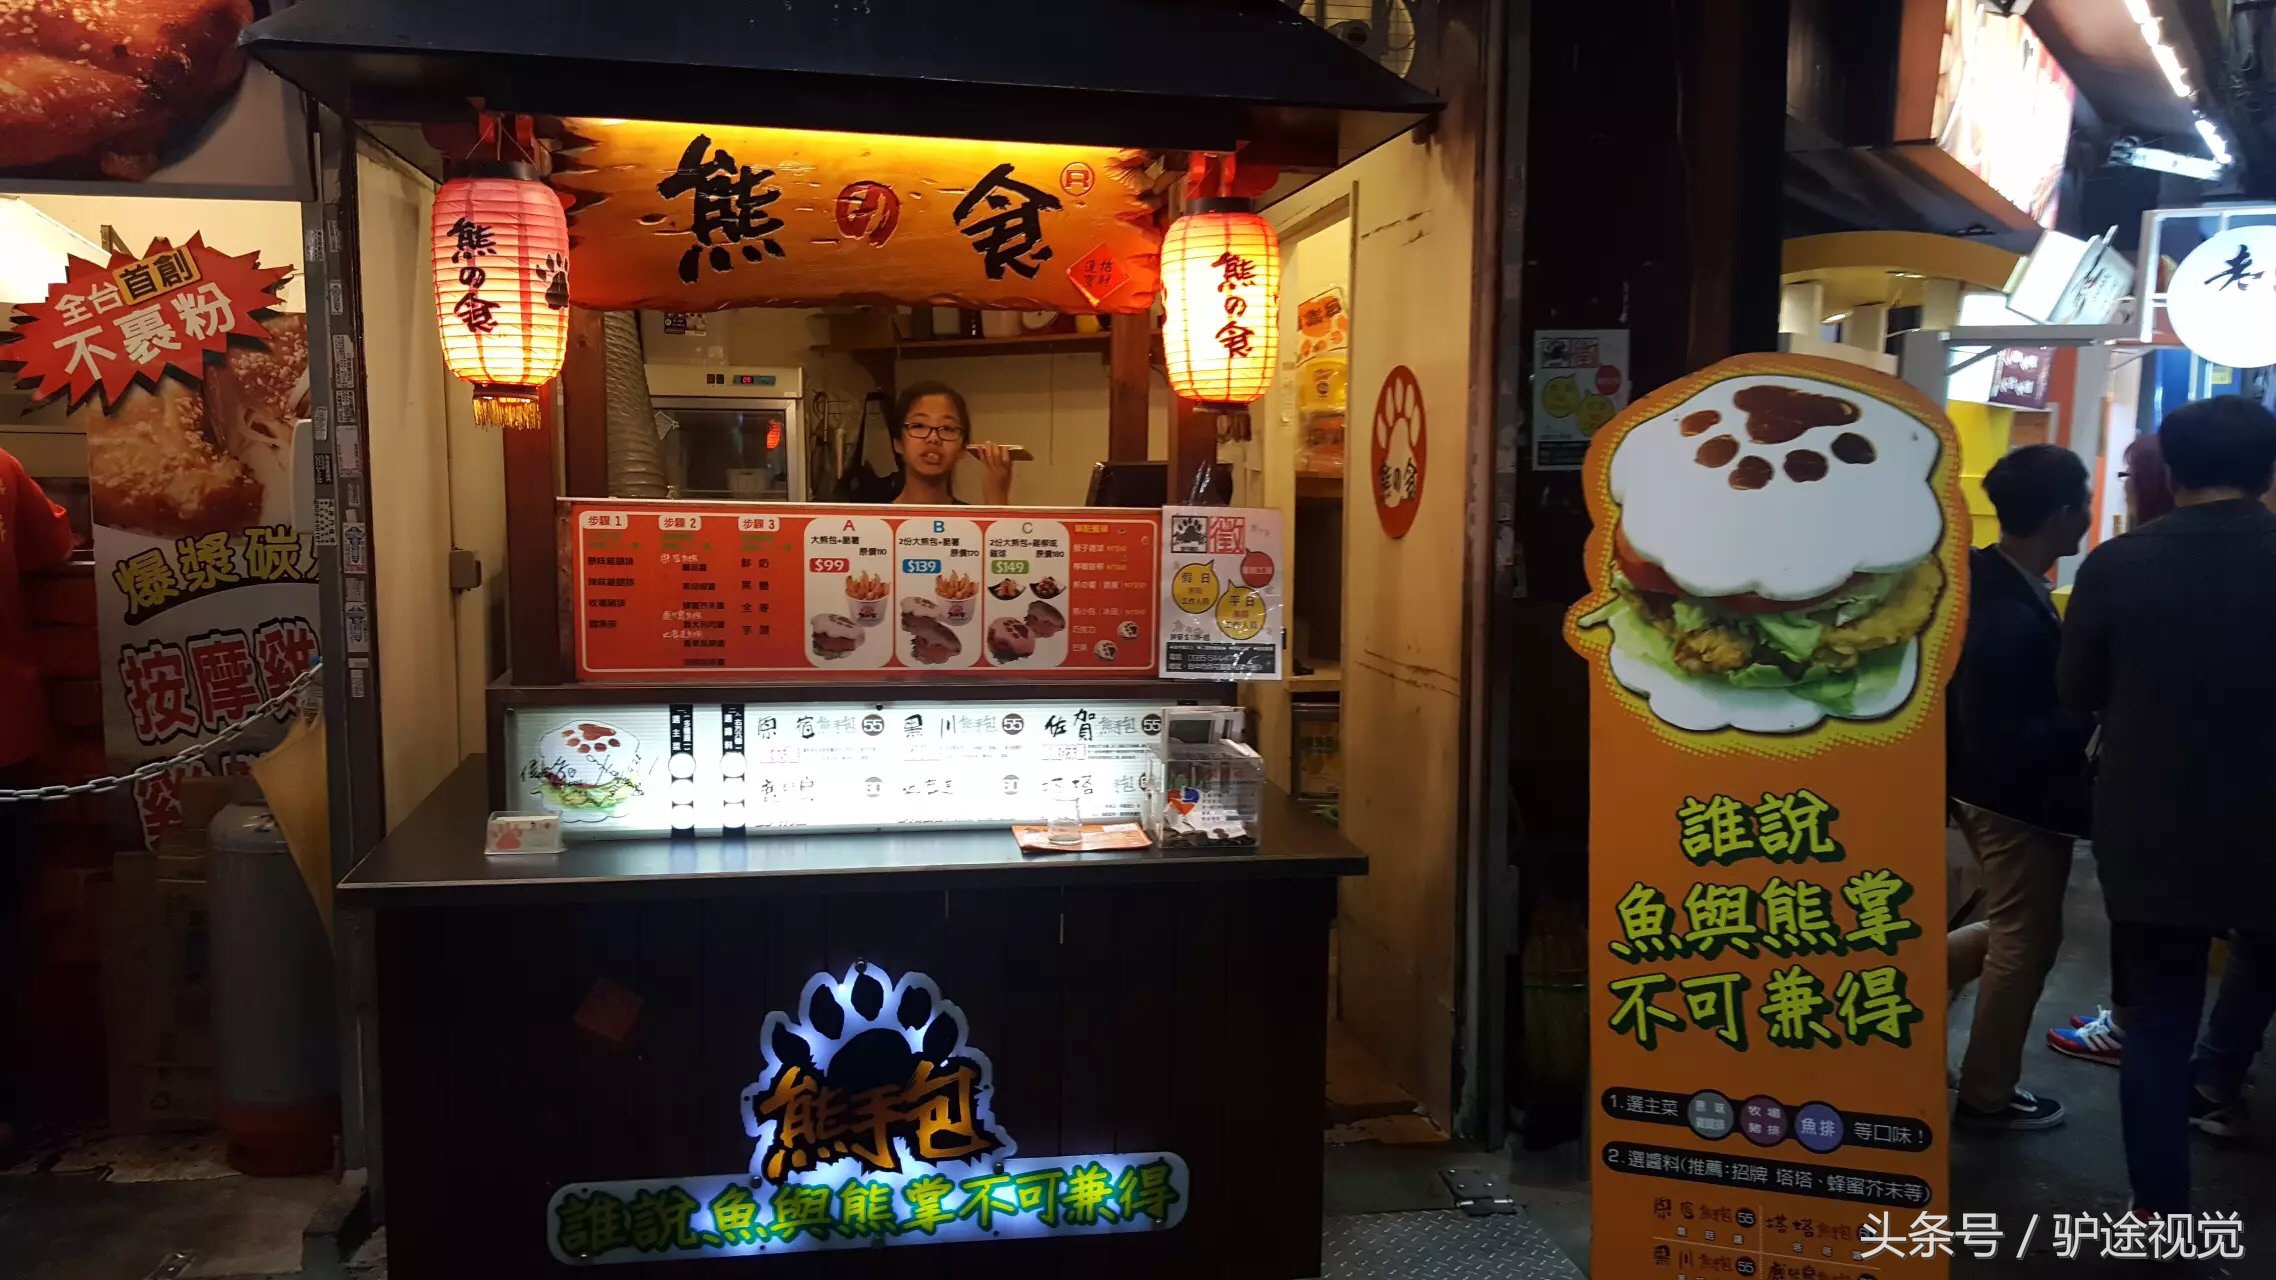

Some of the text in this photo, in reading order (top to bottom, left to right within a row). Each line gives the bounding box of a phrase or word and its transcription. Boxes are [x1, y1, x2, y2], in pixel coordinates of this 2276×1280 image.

[657, 134, 1062, 282] 熊の食
[2204, 244, 2276, 293] 老
[54, 252, 193, 326] 全台 首創
[53, 281, 233, 381] 不裹粉
[615, 516, 622, 527] 1
[690, 518, 697, 529] 2
[768, 519, 775, 530] 3
[843, 520, 856, 532] A
[933, 521, 946, 533] B
[1022, 522, 1034, 534] C
[113, 525, 319, 616] 爆漿碳
[815, 559, 845, 572] $99
[908, 560, 937, 573] $139
[995, 561, 1024, 574] $149
[862, 714, 885, 736] 55
[1002, 713, 1025, 735] 55
[1044, 708, 1097, 741] 佐賀
[1677, 788, 1844, 865] 誰說
[1608, 868, 1921, 961] 魚與熊掌
[1608, 964, 1922, 1050] 不可兼得
[1609, 1094, 1679, 1117] 1.選主菜
[759, 1060, 995, 1179] 熊手包
[1800, 1117, 1836, 1138] 魚排
[1737, 1212, 1755, 1225] 55
[1737, 1260, 1755, 1274] 55
